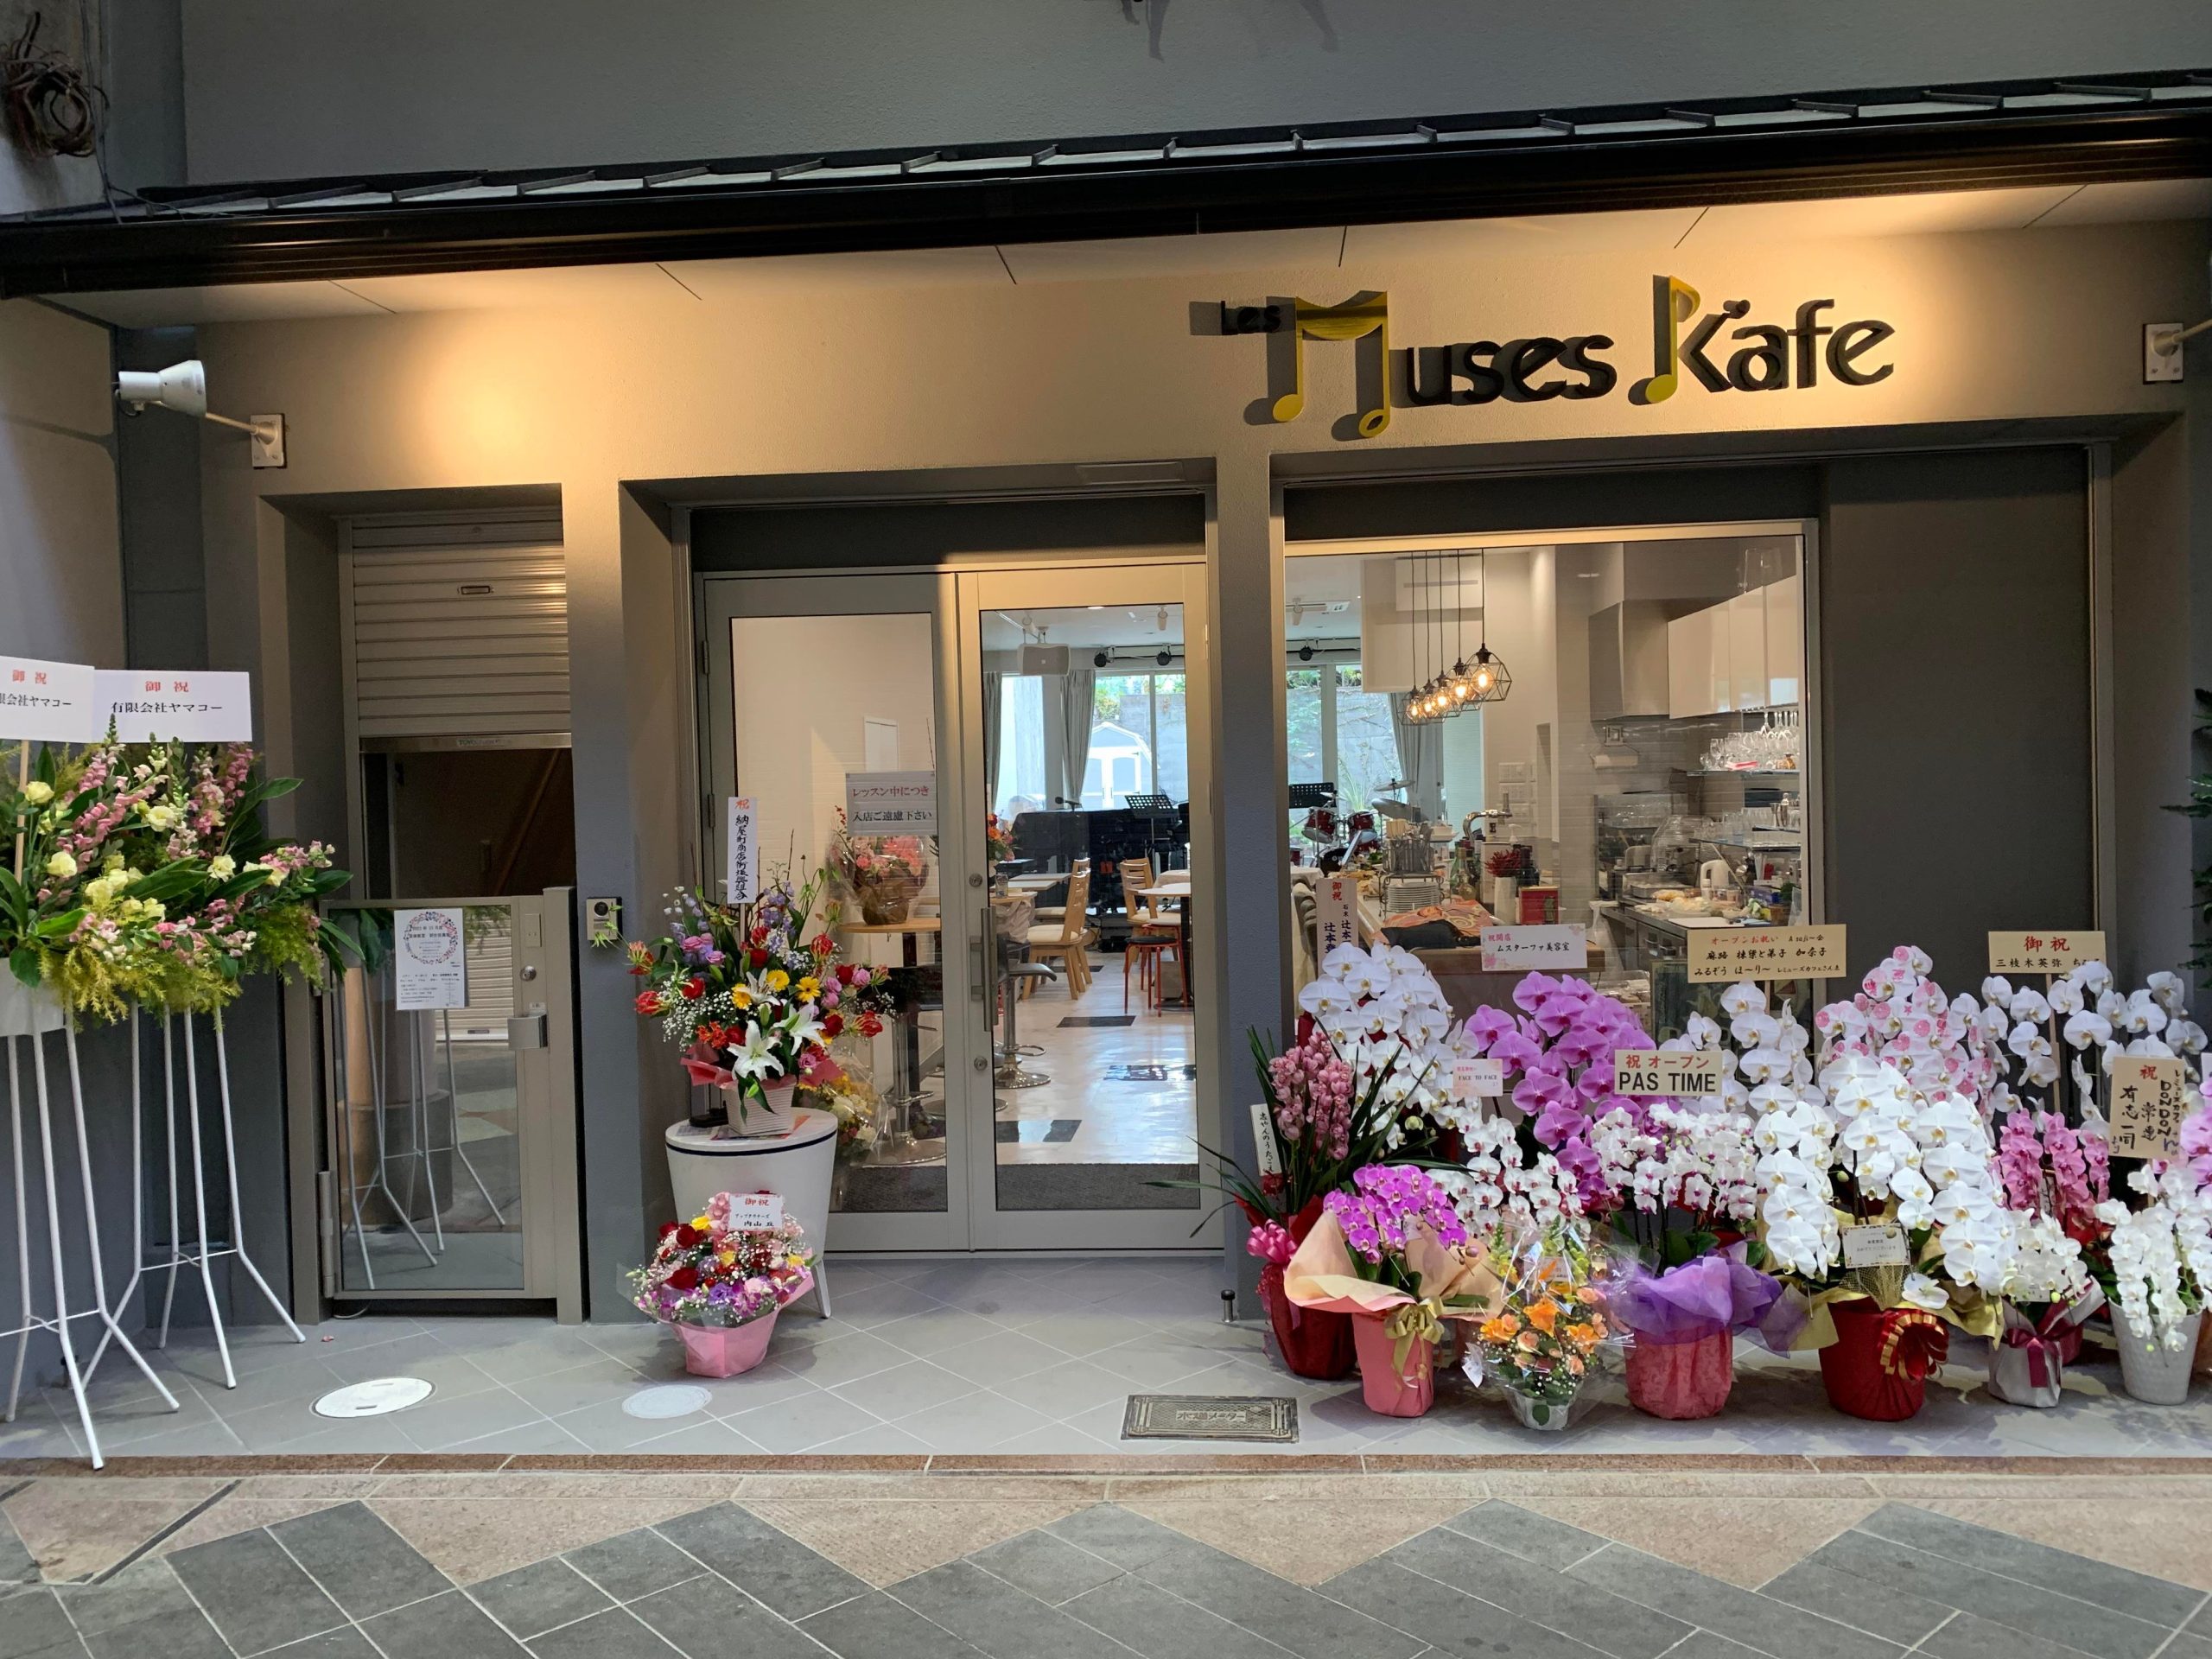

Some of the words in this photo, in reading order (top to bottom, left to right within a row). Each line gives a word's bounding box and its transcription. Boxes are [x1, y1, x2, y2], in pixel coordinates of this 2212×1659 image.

[1220, 300, 1282, 336] Les
[1272, 290, 1618, 439] Muses
[110, 702, 223, 714] 有限会社ヤマコー
[852, 785, 930, 798] レッスン中につき
[735, 798, 750, 810] 祝
[852, 810, 932, 822] 入店ご遠慮下さい
[1332, 881, 1343, 901] 御祝
[1488, 933, 1511, 942] 祝開店
[1497, 941, 1571, 952] ムスターファ美容室
[2024, 935, 2070, 953] 御祝
[1995, 957, 2063, 969] 三枝木英弥
[2139, 1065, 2158, 1080] 祝
[1618, 1071, 1659, 1091] PAS
[1668, 1072, 1717, 1092] TIME
[745, 1198, 770, 1207] 御祝
